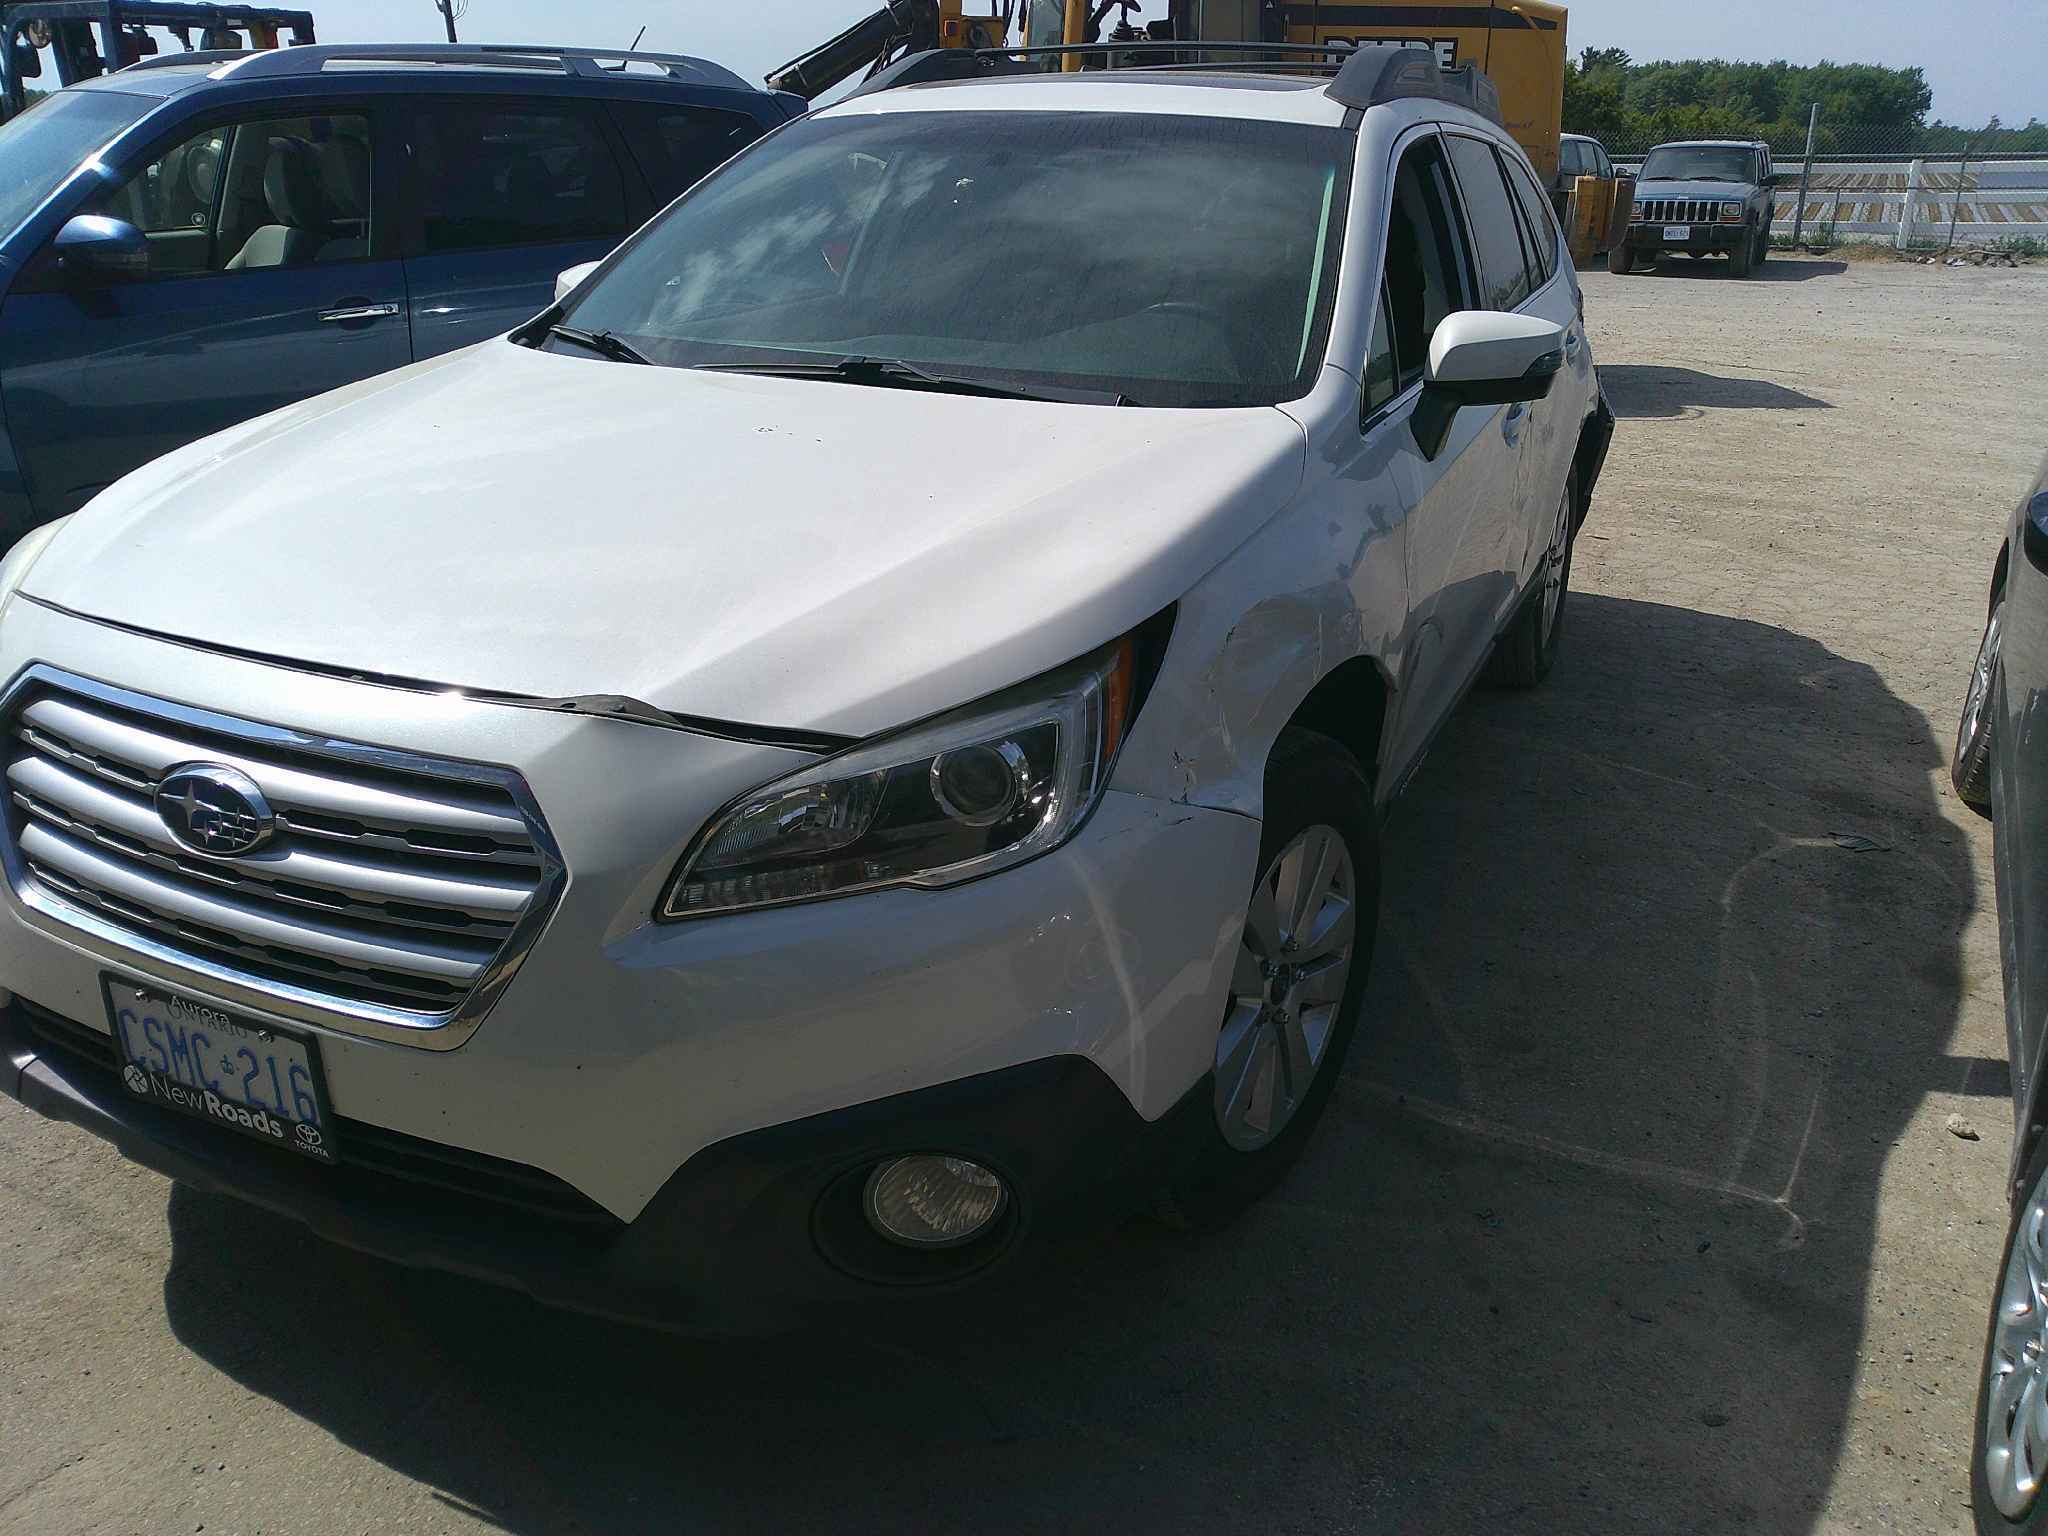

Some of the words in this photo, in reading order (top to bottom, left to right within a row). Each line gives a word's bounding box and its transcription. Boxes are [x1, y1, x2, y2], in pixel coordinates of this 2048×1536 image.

[170, 995, 230, 1024] Aurora
[118, 1008, 220, 1091] CSMC
[237, 1046, 321, 1126] 216
[151, 1072, 284, 1139] NewRoads
[294, 1139, 330, 1158] TOYOTA
